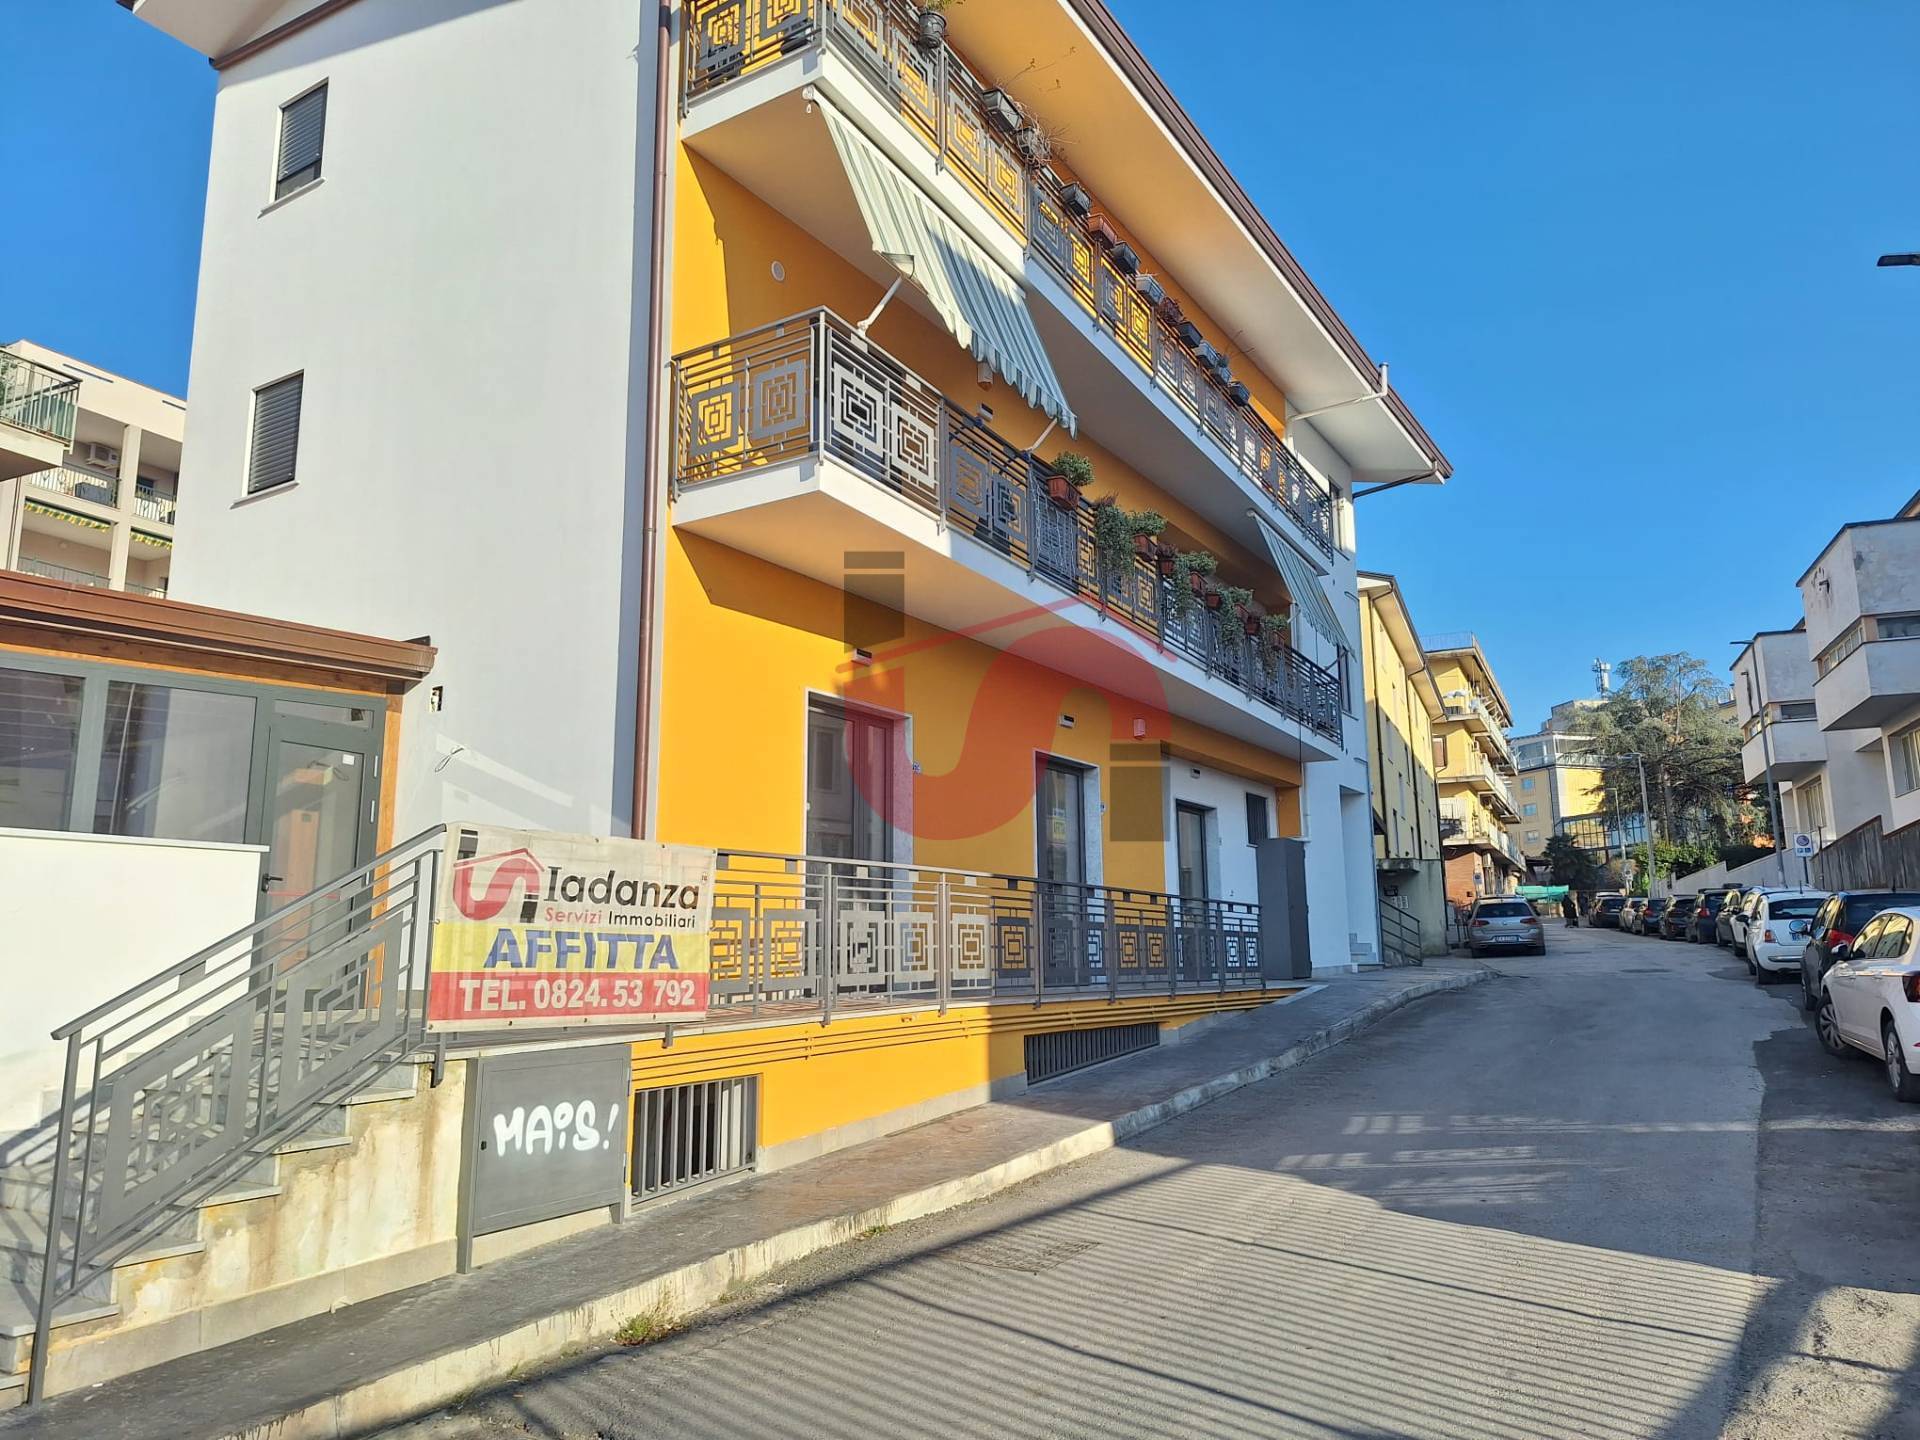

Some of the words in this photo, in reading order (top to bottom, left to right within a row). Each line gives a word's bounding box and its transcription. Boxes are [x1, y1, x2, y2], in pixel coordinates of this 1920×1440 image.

[544, 866, 700, 910] Iadanza
[545, 907, 603, 924] Servizi
[608, 911, 696, 928] Immobiliari
[483, 928, 679, 969] AFFITTA
[459, 980, 526, 1011] TEL.
[653, 980, 696, 1006] 792
